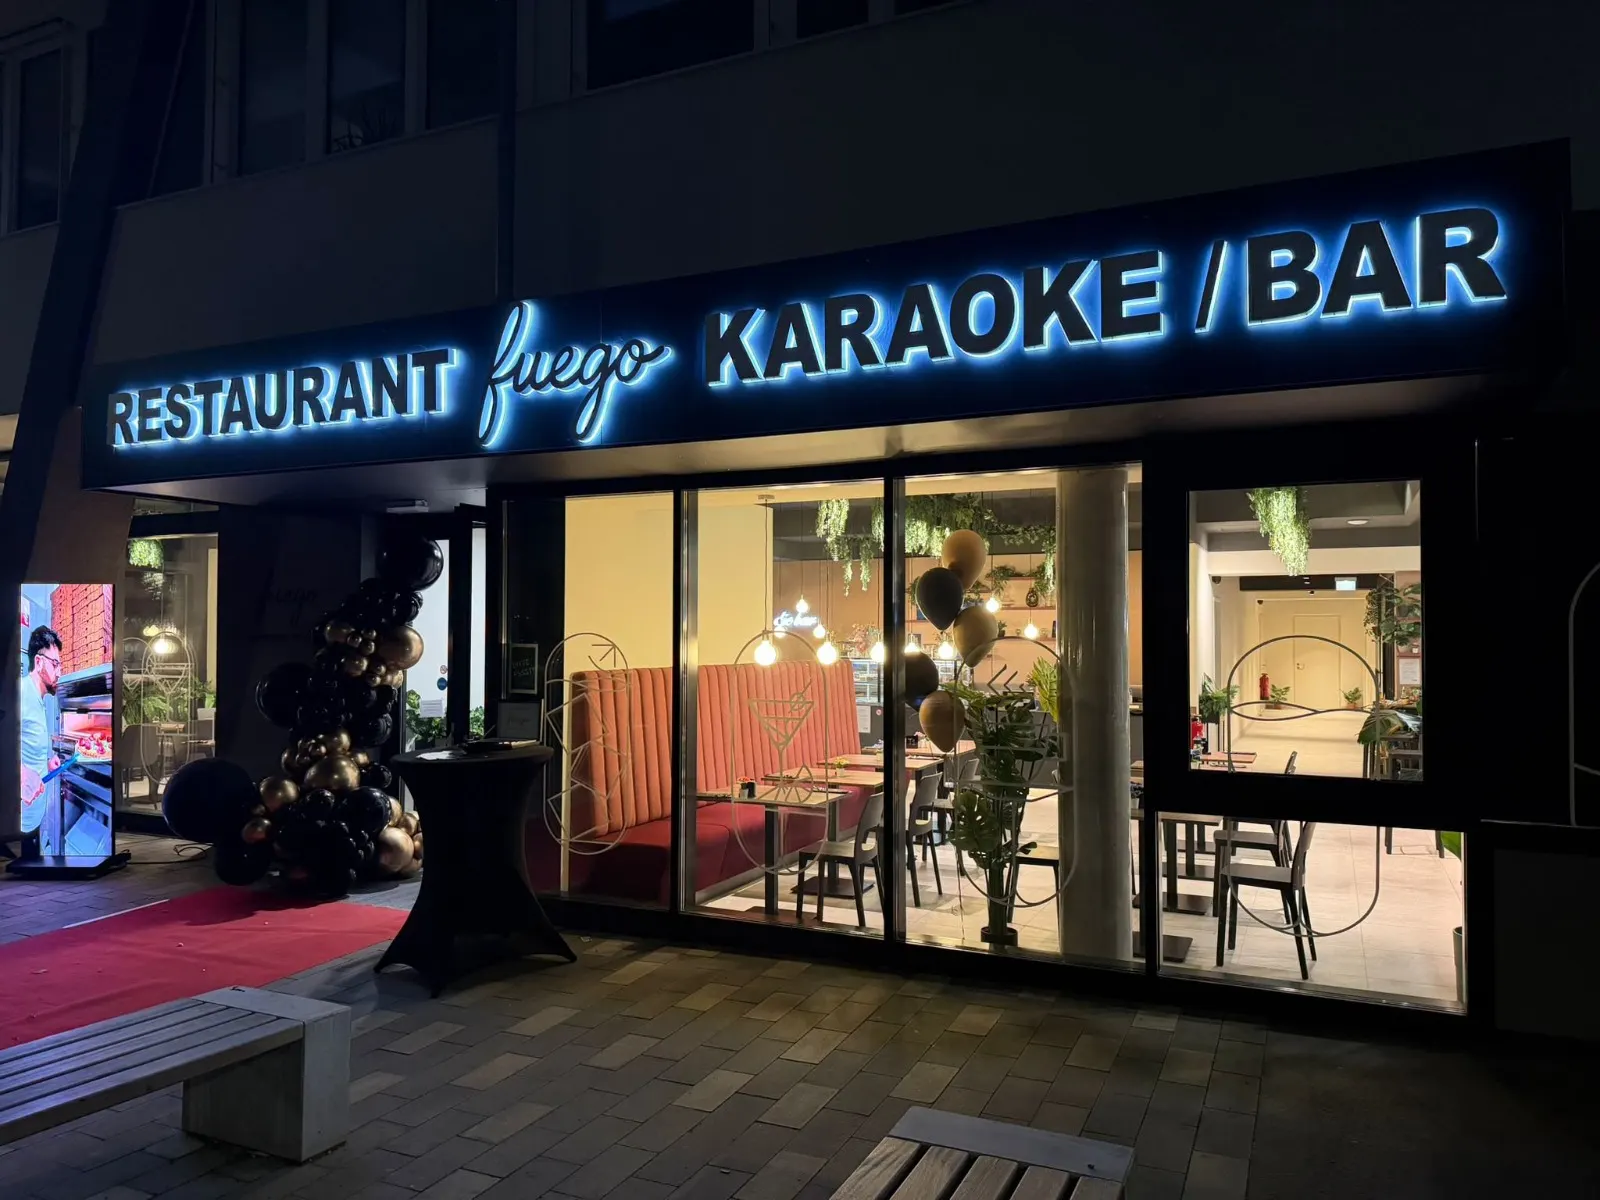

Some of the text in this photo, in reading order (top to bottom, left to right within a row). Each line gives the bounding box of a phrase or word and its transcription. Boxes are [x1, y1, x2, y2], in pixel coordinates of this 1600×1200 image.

[106, 348, 457, 447] RESTAURANT
[478, 299, 673, 447] fuego
[704, 249, 1164, 388] KARAOKE
